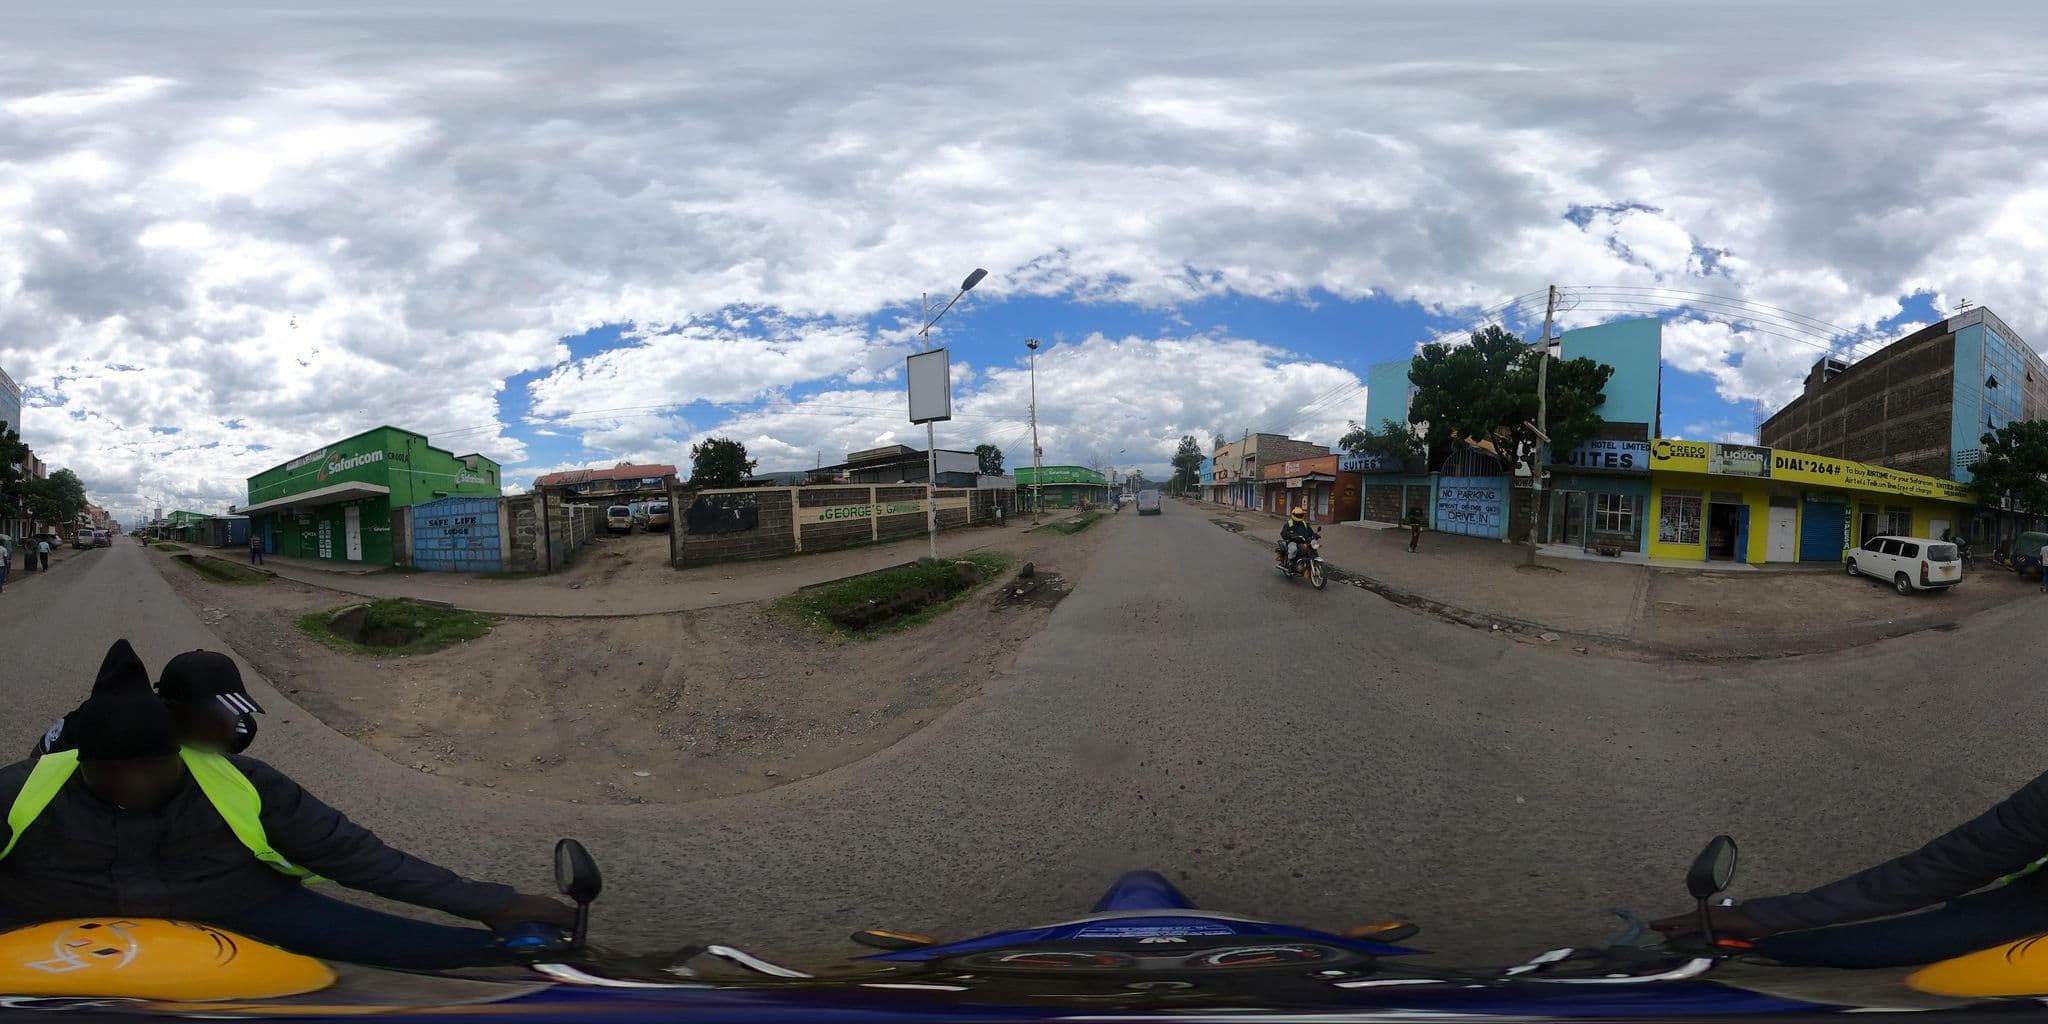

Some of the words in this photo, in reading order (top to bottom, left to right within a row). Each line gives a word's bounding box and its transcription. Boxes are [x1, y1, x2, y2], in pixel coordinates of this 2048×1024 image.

[1592, 441, 1616, 449] HOTEL
[1622, 442, 1651, 451] LIMITED
[1670, 445, 1705, 454] CREDO
[1567, 450, 1633, 468] UITES
[1723, 450, 1763, 461] LIQUOR
[328, 450, 383, 474] Safaricom
[1344, 460, 1376, 470] SUITES
[1846, 466, 1853, 474] To
[1854, 468, 1865, 477] buy
[1867, 470, 1889, 479] AIRTIME
[1442, 490, 1452, 498] NO
[1457, 490, 1495, 499] PARKING
[825, 504, 881, 519] GEORGE'S
[1448, 511, 1475, 522] DRIVE
[455, 517, 476, 525] LIFE
